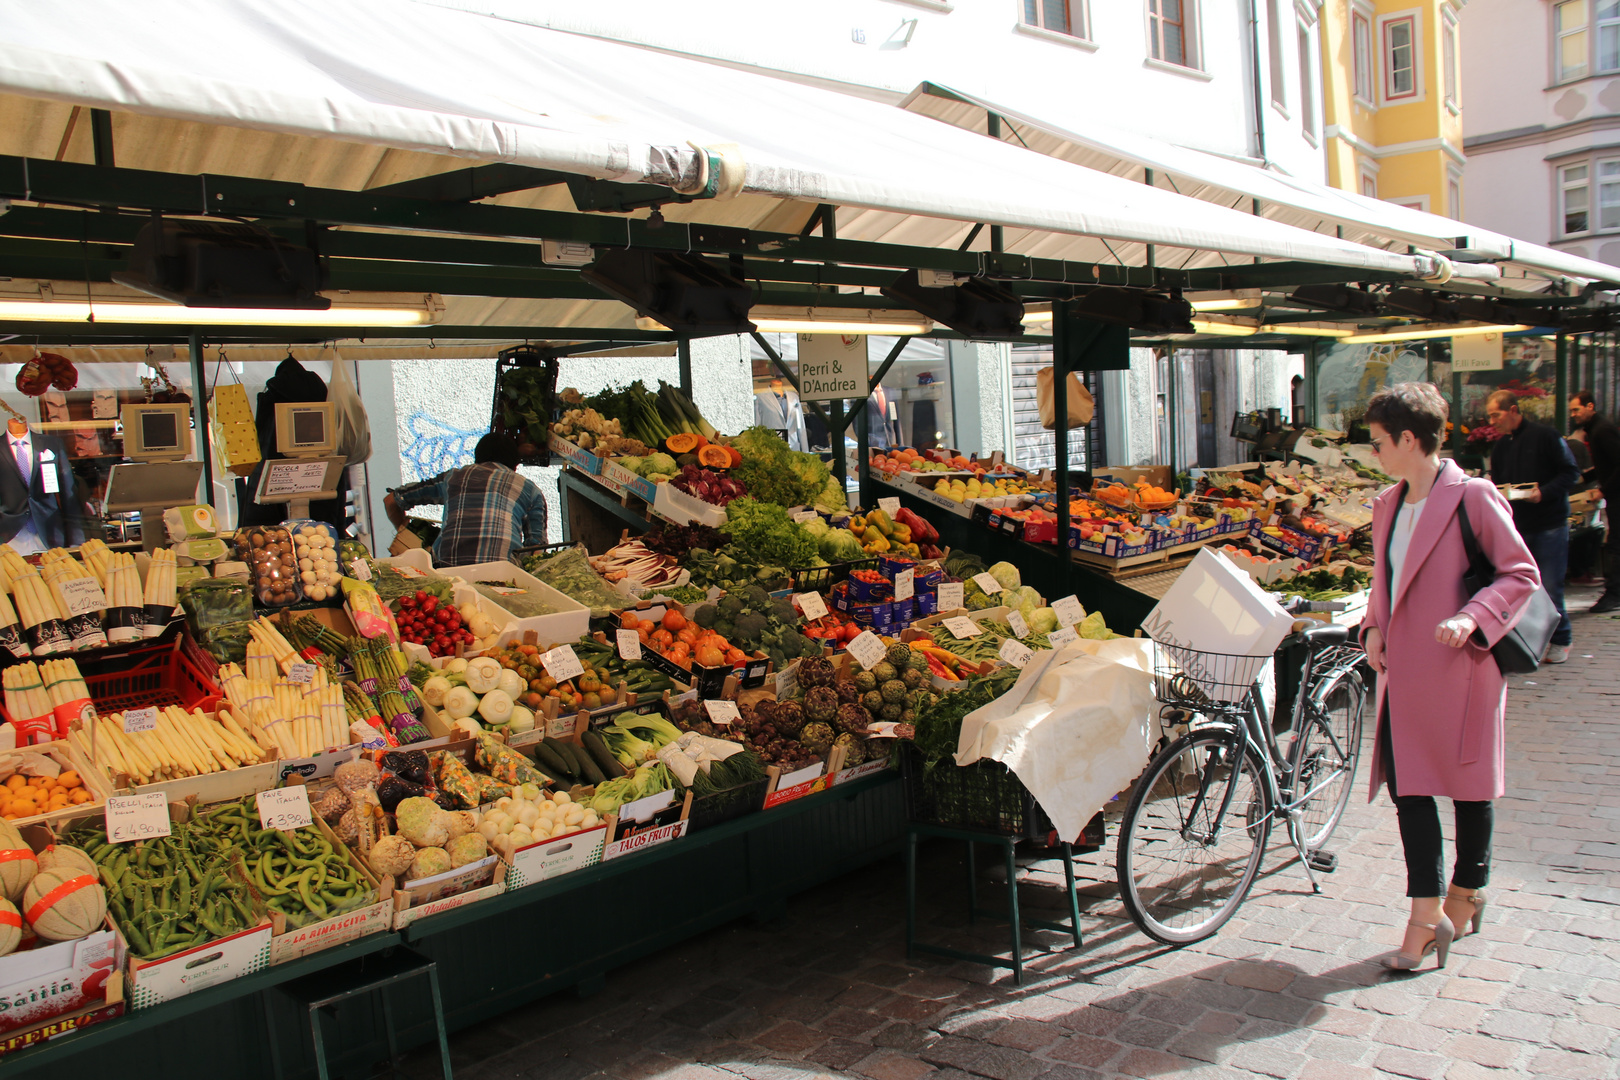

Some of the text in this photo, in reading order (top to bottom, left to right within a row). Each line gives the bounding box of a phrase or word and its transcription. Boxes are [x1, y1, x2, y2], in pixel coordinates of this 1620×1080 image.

[855, 28, 866, 42] 15
[802, 359, 843, 377] Perri &
[1471, 359, 1491, 367] Fava
[803, 377, 857, 394] D'Andrea
[556, 440, 590, 467] L'AMANTE
[613, 468, 649, 495] L'AMANTE
[262, 791, 282, 799] FAVE
[791, 782, 812, 794] FRUTTA
[109, 798, 141, 810] PISELLI
[276, 796, 301, 804] ITALIA
[277, 814, 302, 827] 3,90
[114, 826, 126, 840] €
[619, 833, 647, 852] TALOS
[648, 826, 673, 843] FRUIT
[424, 896, 464, 915] Natalini
[292, 933, 307, 944] LA
[309, 914, 367, 939] RINASCITA
[212, 962, 230, 973] SUR
